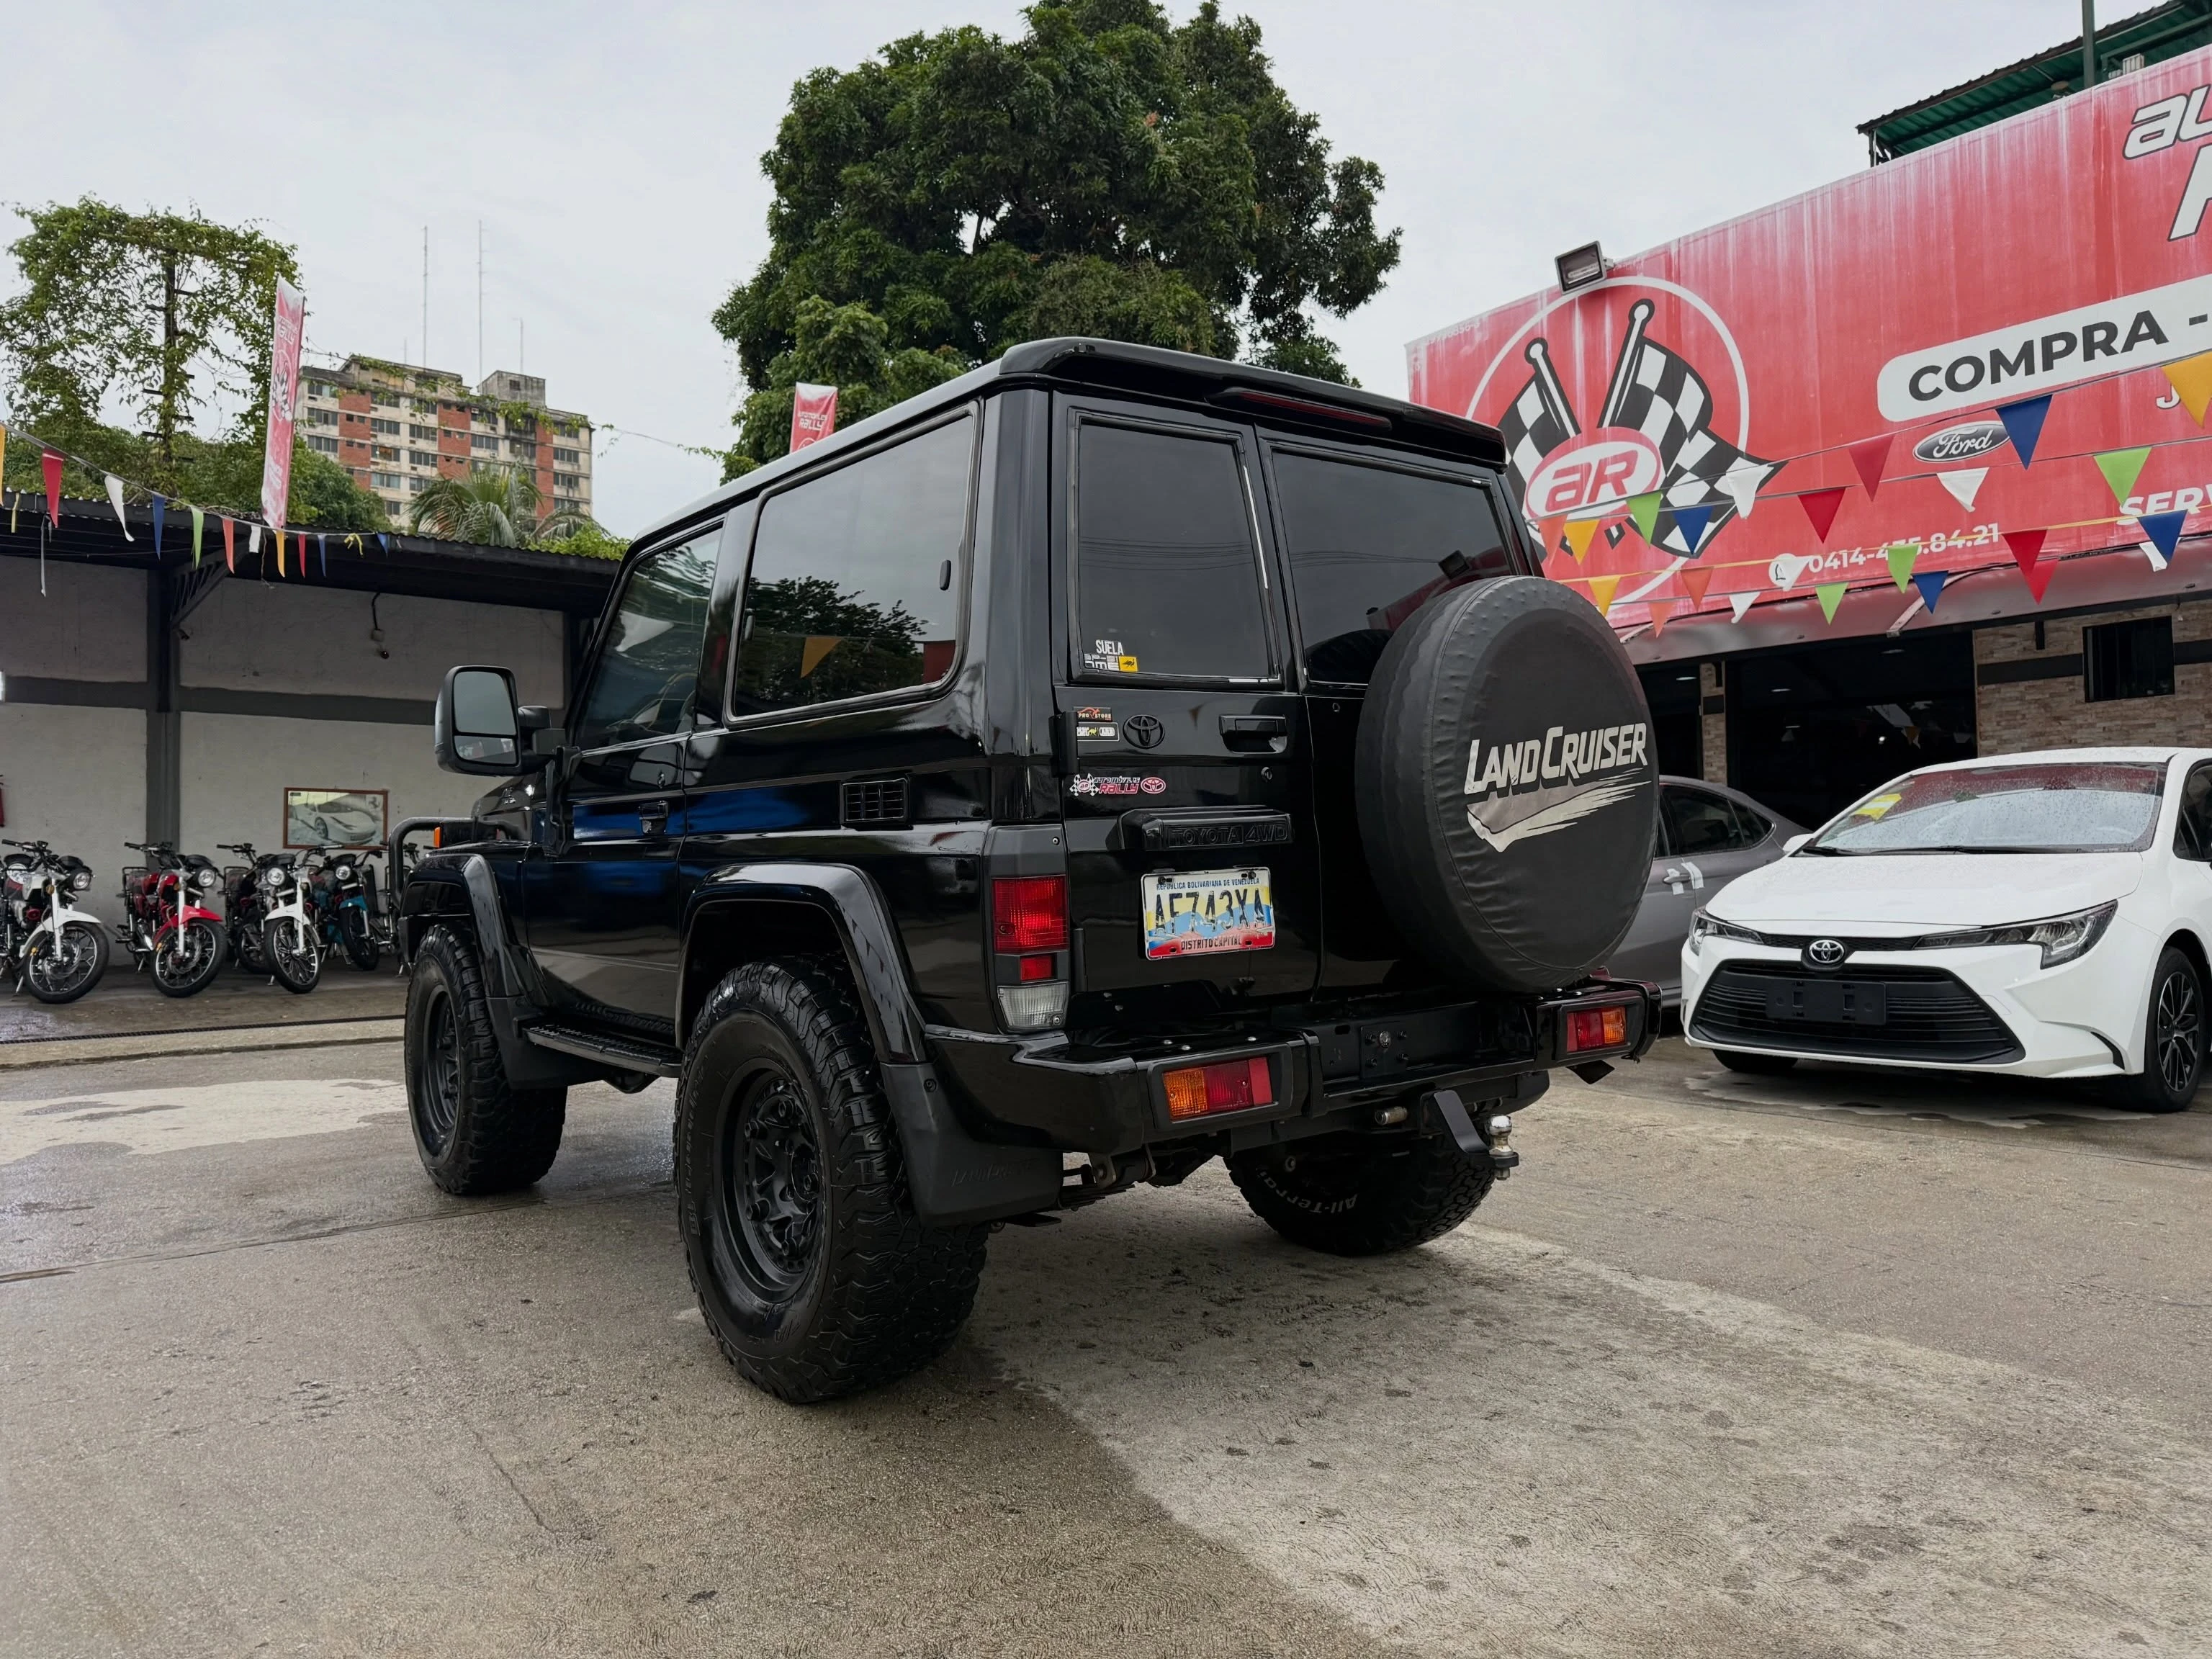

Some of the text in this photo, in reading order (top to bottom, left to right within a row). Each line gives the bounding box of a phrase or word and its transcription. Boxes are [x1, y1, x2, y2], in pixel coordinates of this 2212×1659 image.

[1908, 310, 2170, 401] COMPRA
[1933, 427, 1994, 458] Ford
[1095, 639, 1124, 655] SUELA
[1172, 823, 1288, 845] TOYOTA 4WD
[1187, 879, 1222, 889] BOLIVARIANA
[1180, 938, 1213, 951] DISTRITO
